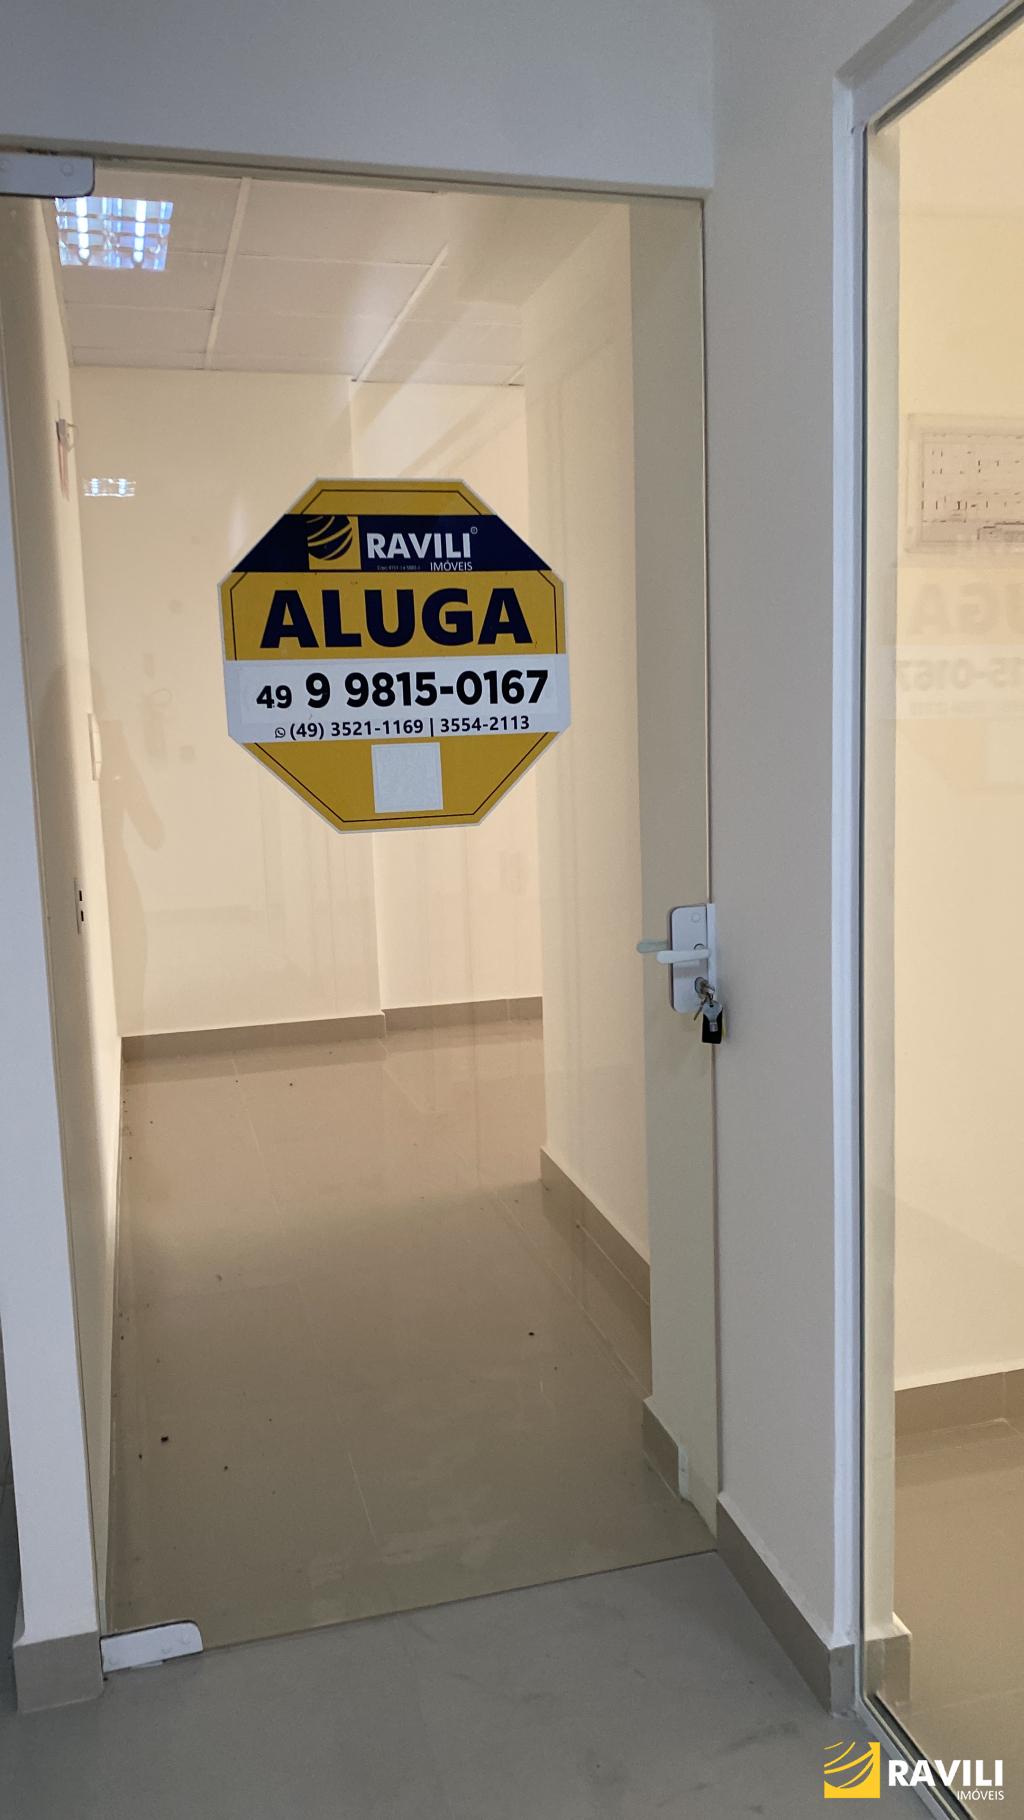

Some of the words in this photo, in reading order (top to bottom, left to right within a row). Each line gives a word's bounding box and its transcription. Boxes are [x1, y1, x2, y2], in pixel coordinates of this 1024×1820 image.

[430, 560, 473, 572] IMÓVEIS
[260, 587, 533, 649] ALUGA
[256, 685, 292, 709] 49
[305, 672, 331, 709] 9
[344, 669, 549, 708] 9815-0167
[290, 722, 324, 740] (49)
[331, 719, 424, 737] 3521-1169
[440, 715, 530, 733] 3554-2113
